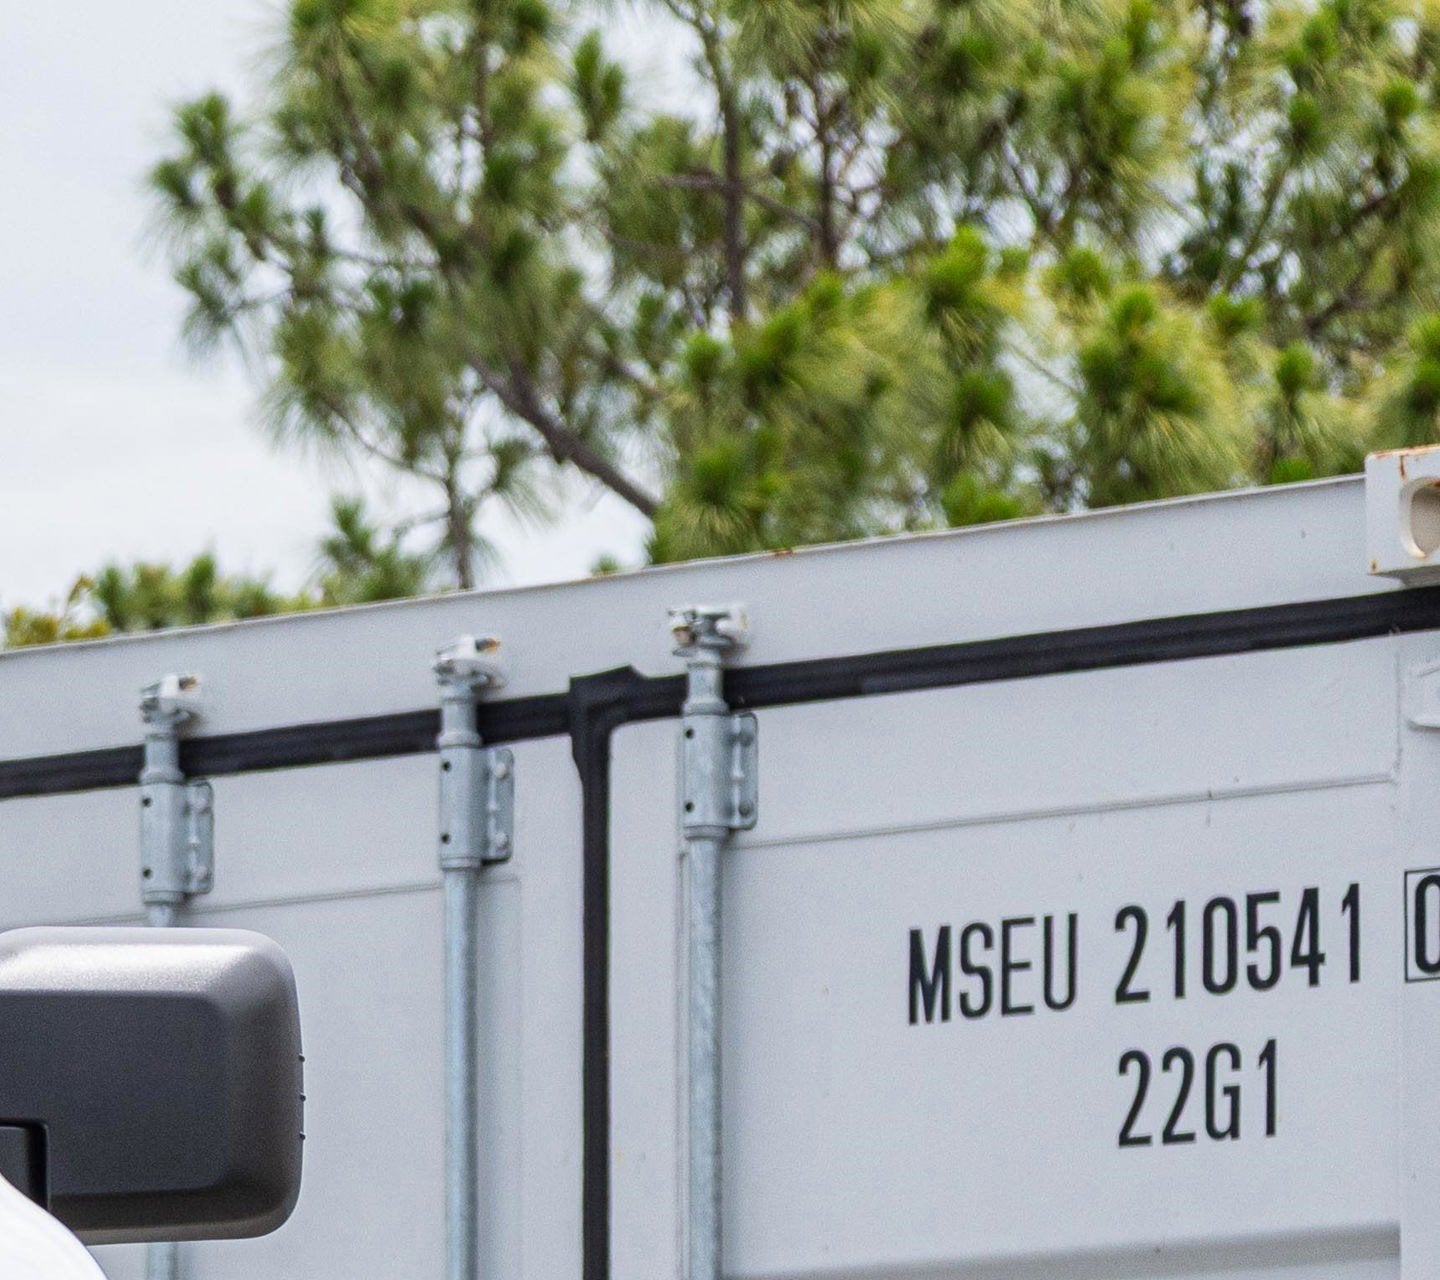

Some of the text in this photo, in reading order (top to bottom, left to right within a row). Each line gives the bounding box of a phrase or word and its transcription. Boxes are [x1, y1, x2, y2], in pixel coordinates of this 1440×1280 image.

[908, 875, 1440, 1026] MSEU 210541 0
[1118, 1039, 1277, 1148] 22G1
